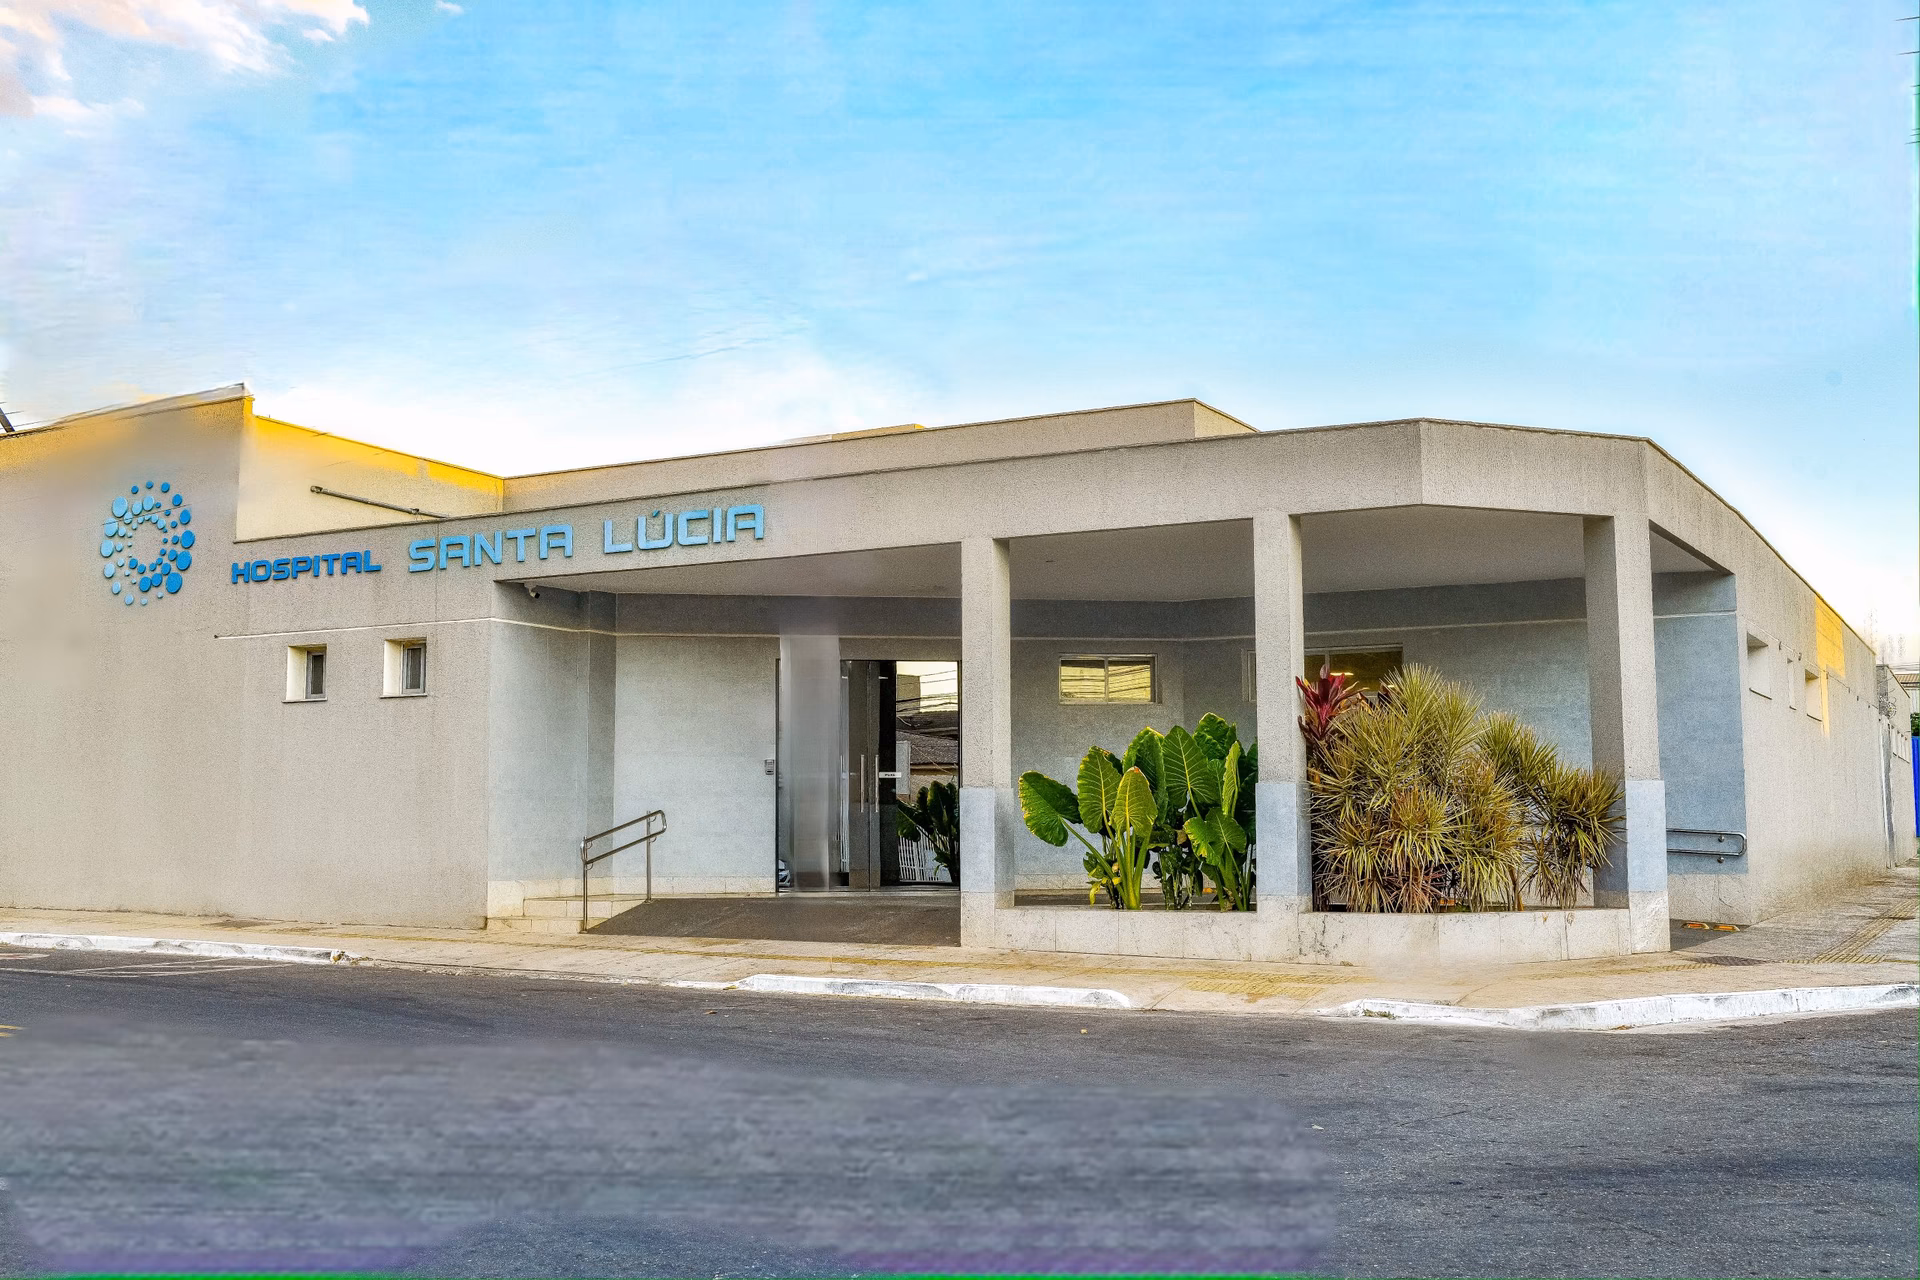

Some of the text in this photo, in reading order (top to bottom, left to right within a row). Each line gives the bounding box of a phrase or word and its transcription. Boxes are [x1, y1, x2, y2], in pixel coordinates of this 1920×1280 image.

[231, 504, 765, 584] HOSPITAL SANTA LÚCIA
